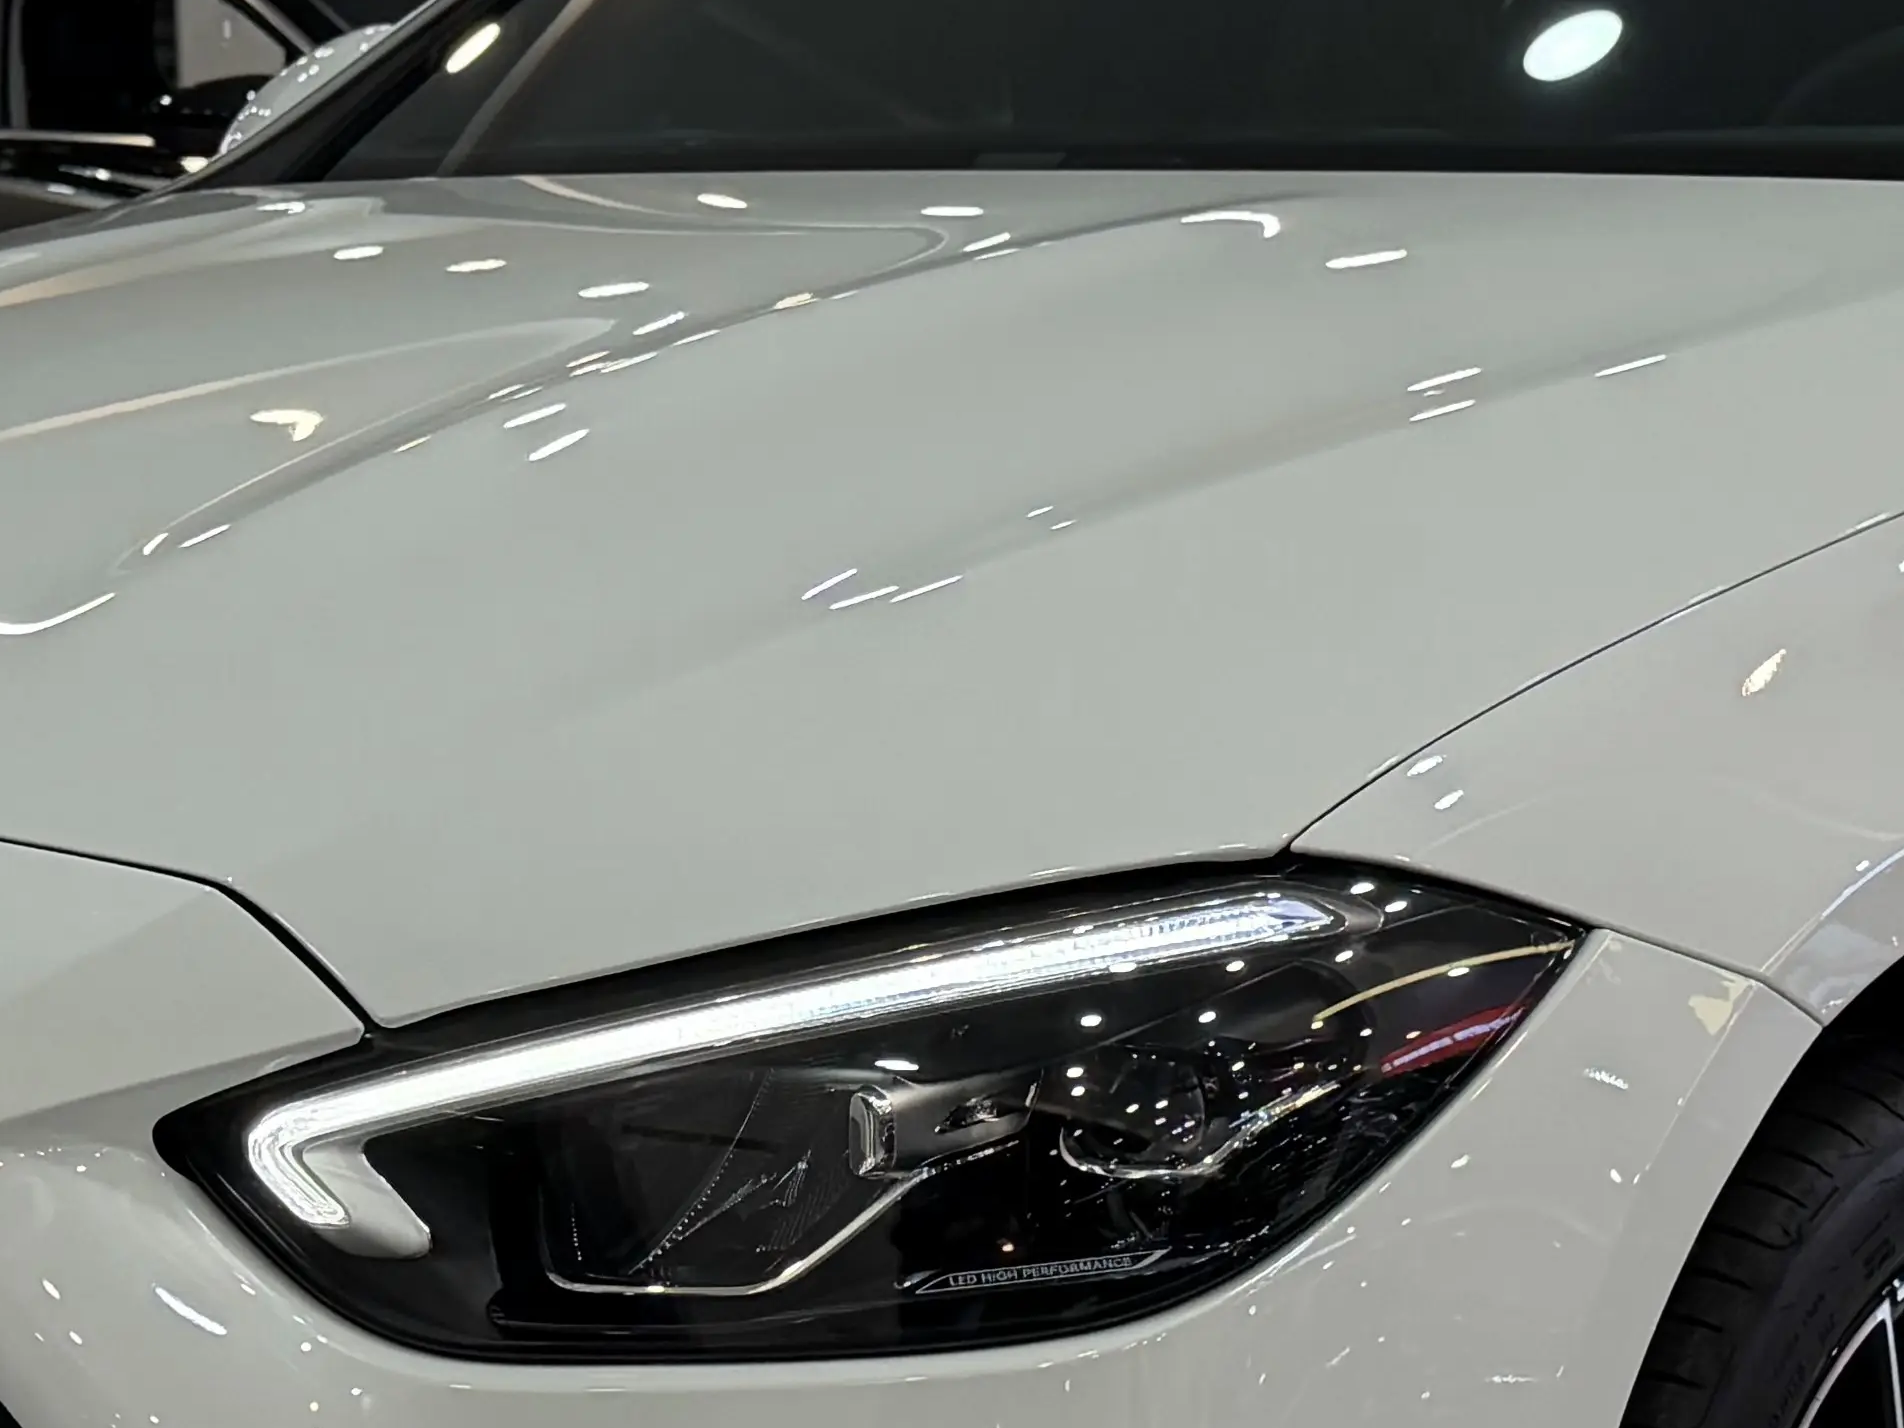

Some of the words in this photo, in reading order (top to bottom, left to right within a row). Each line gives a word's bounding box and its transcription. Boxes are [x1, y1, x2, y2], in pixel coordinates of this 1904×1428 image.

[949, 1274, 977, 1287] LED
[981, 1270, 1018, 1283] HIGH
[1022, 1257, 1132, 1277] PERFORMANCE
